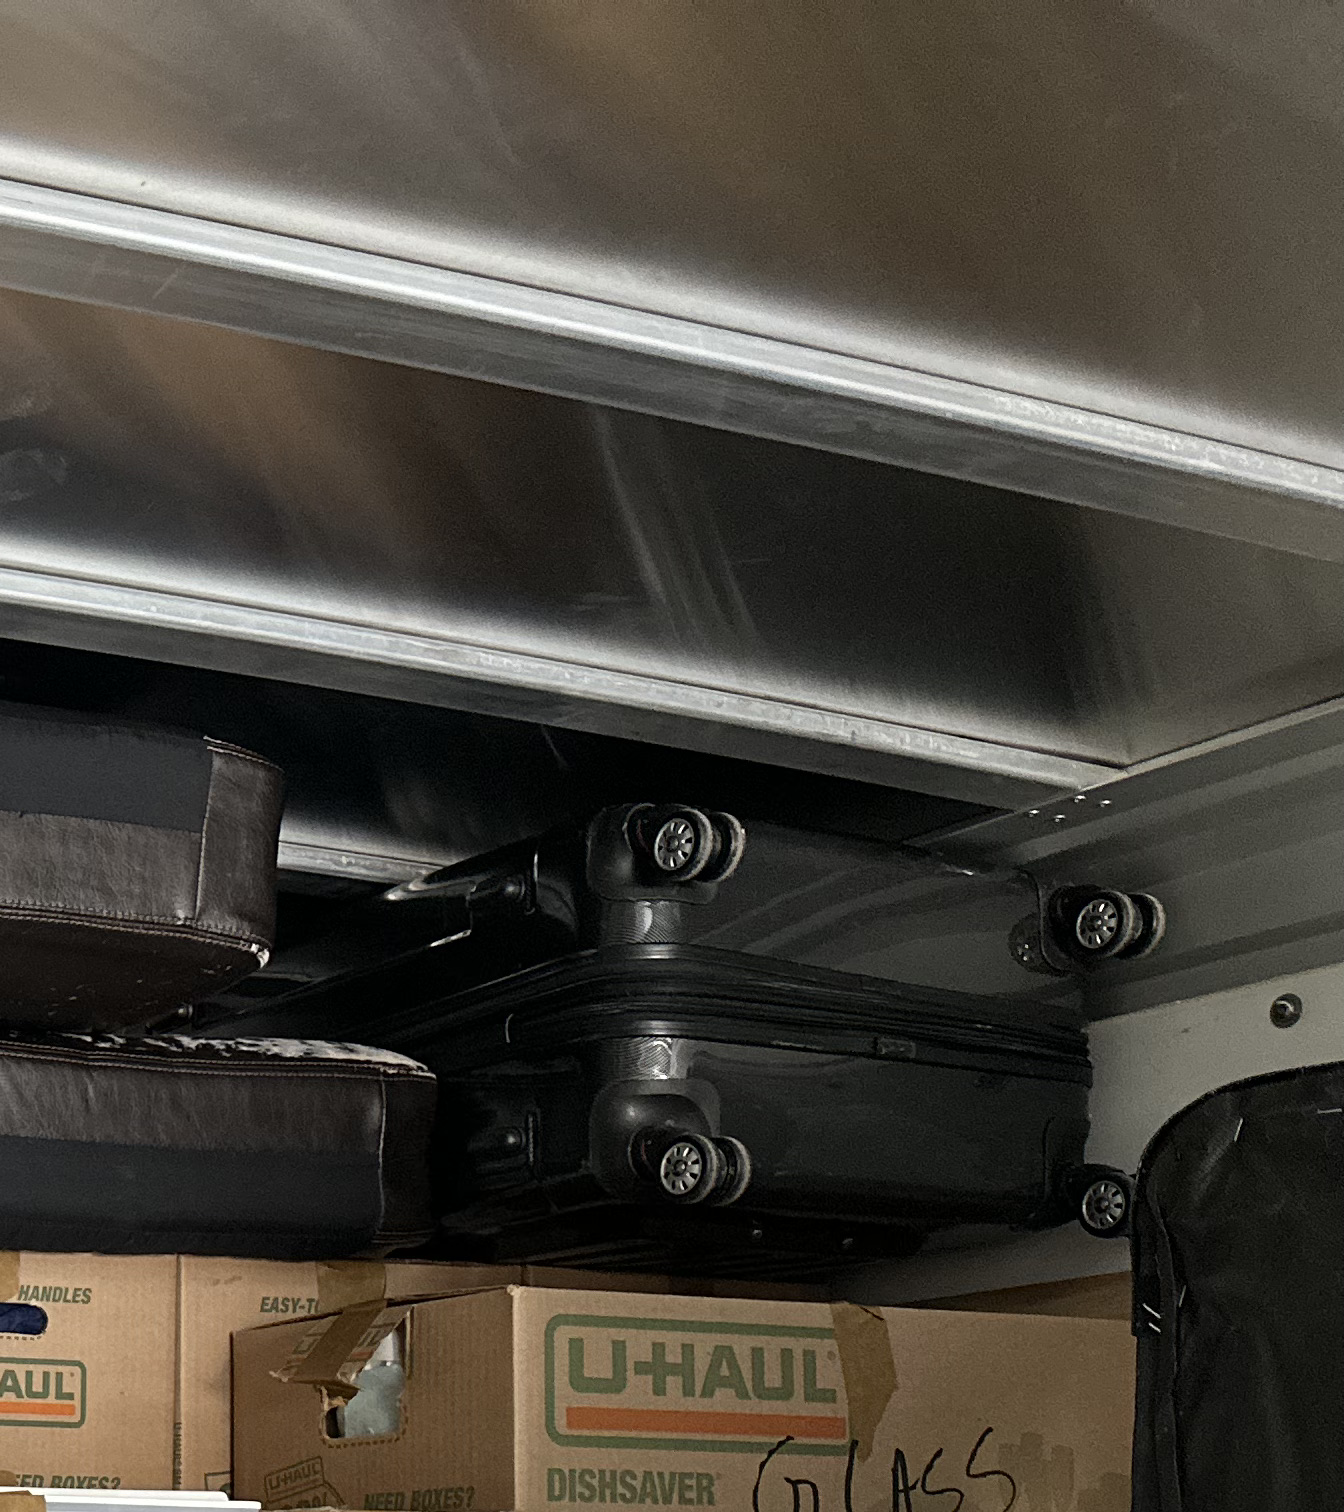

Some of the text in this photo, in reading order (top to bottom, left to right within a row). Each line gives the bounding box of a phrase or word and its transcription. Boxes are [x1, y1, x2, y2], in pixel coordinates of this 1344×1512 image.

[18, 1284, 93, 1304] HANDLES
[568, 1337, 837, 1404] U-HAUL
[548, 1467, 716, 1506] DISHSAVER
